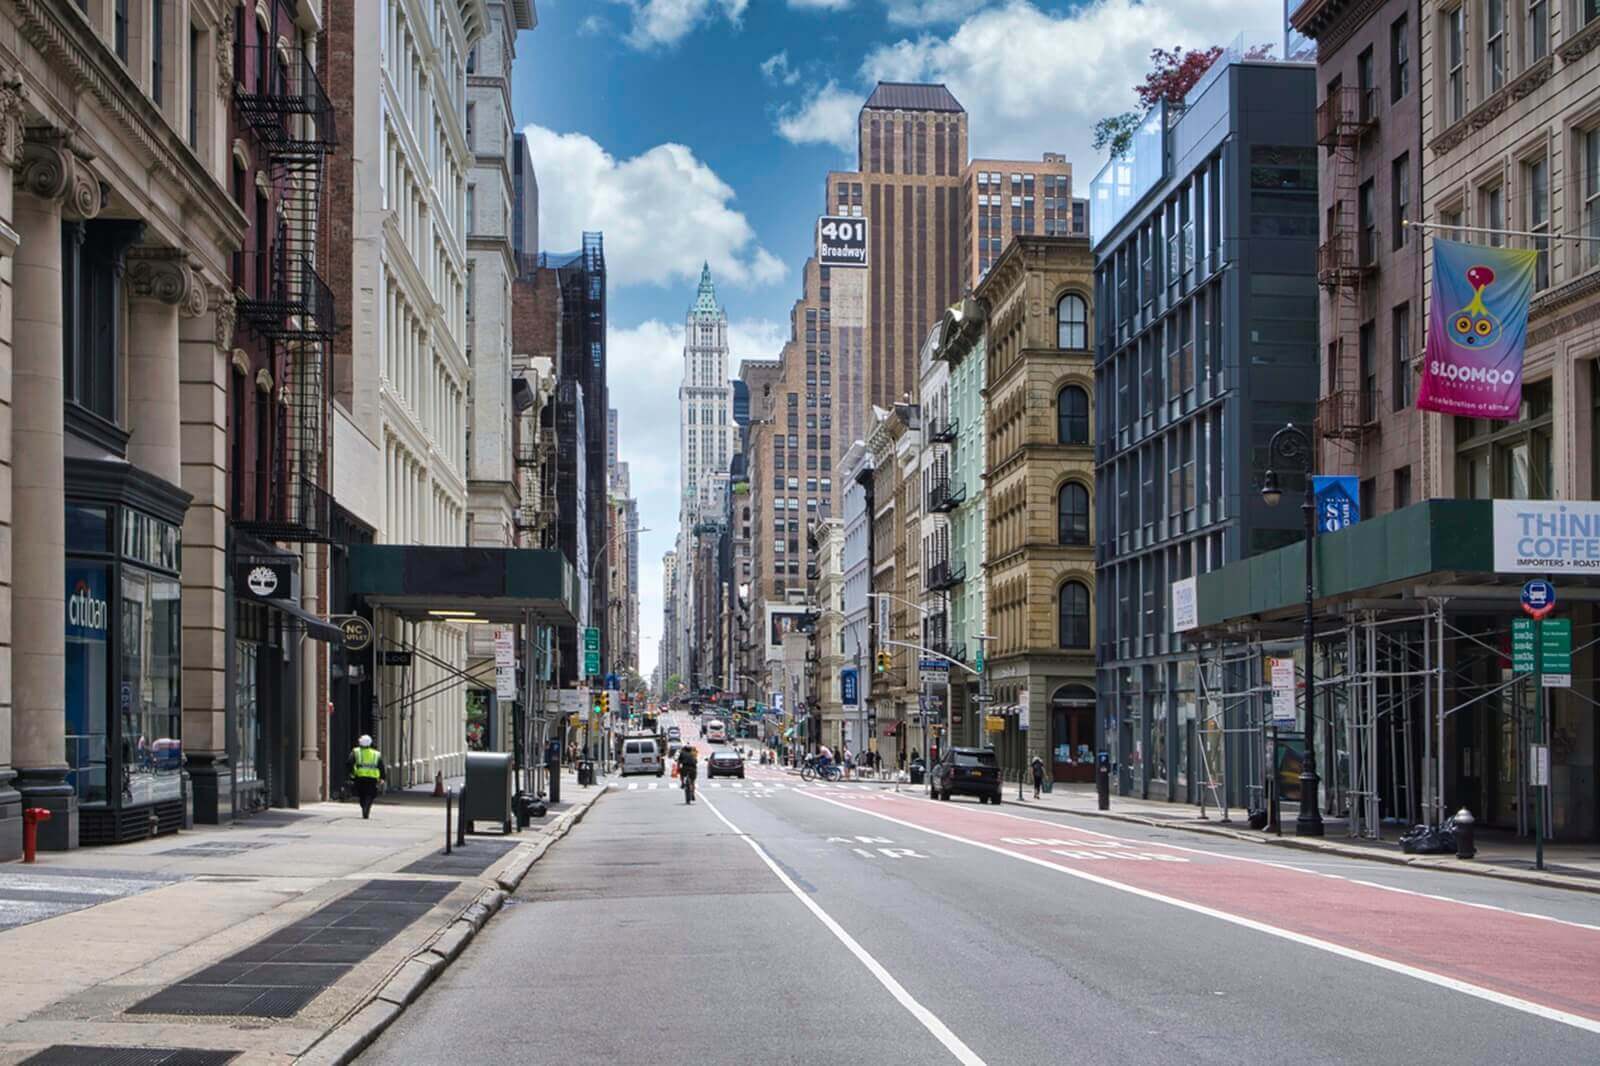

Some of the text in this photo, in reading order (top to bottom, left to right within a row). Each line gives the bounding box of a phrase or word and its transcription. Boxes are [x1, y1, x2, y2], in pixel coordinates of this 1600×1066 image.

[822, 222, 863, 241] 401
[822, 243, 866, 261] Broadway
[1431, 361, 1515, 388] SLOOMOO
[1441, 381, 1497, 392] INSTITUT
[1434, 397, 1476, 409] celebration
[1488, 403, 1509, 411] slime
[1517, 538, 1600, 559] COFFE
[1516, 558, 1564, 567] IMPORTERS
[346, 625, 363, 634] NC
